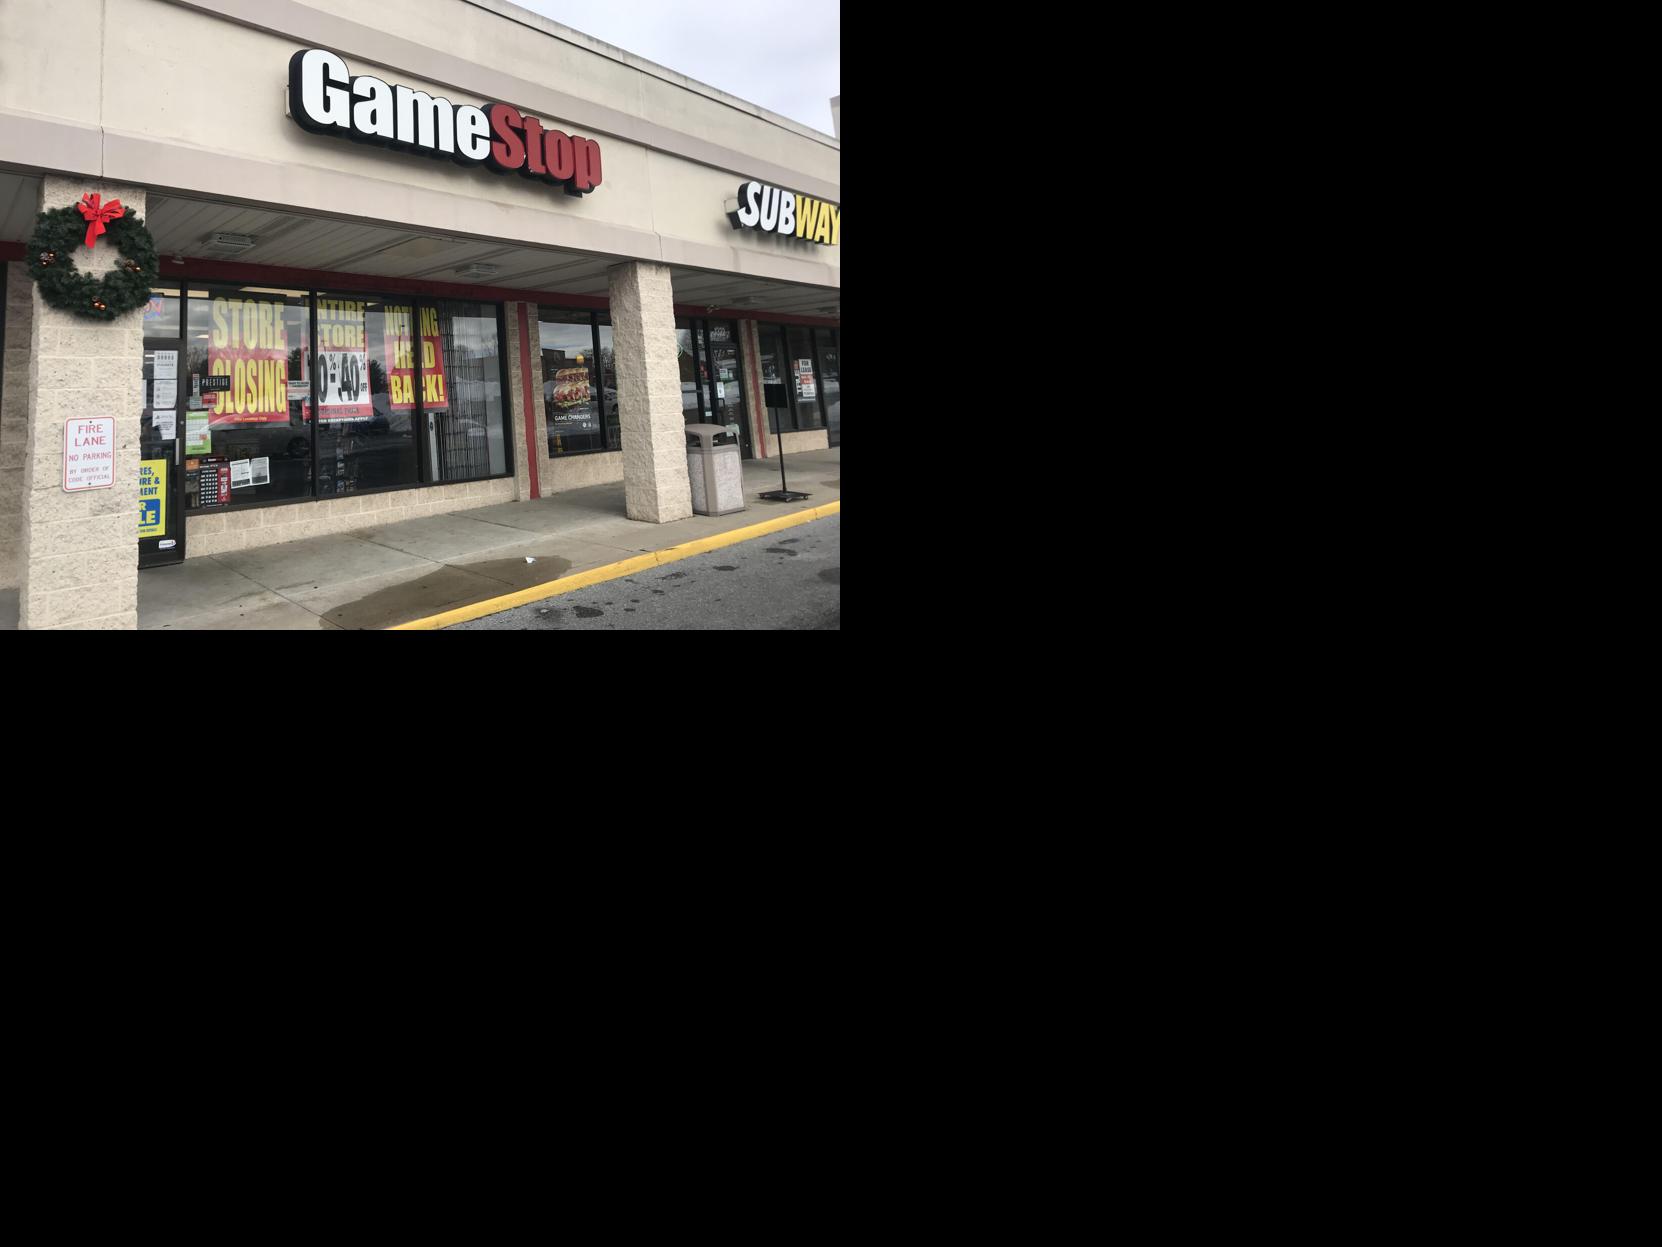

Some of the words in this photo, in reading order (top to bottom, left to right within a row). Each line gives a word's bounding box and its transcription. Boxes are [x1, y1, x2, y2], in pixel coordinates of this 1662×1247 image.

[302, 49, 602, 189] GameStop
[737, 181, 840, 245] SUBWAY
[212, 297, 285, 350] STORE
[317, 324, 365, 348] TORE
[393, 340, 436, 369] HED
[212, 358, 287, 415] CLOSING
[78, 424, 104, 434] FIRE
[568, 413, 591, 421] CHANGERS
[74, 436, 107, 447] LANE
[68, 454, 79, 462] NO
[82, 451, 111, 461] PARKING
[154, 477, 160, 485] &
